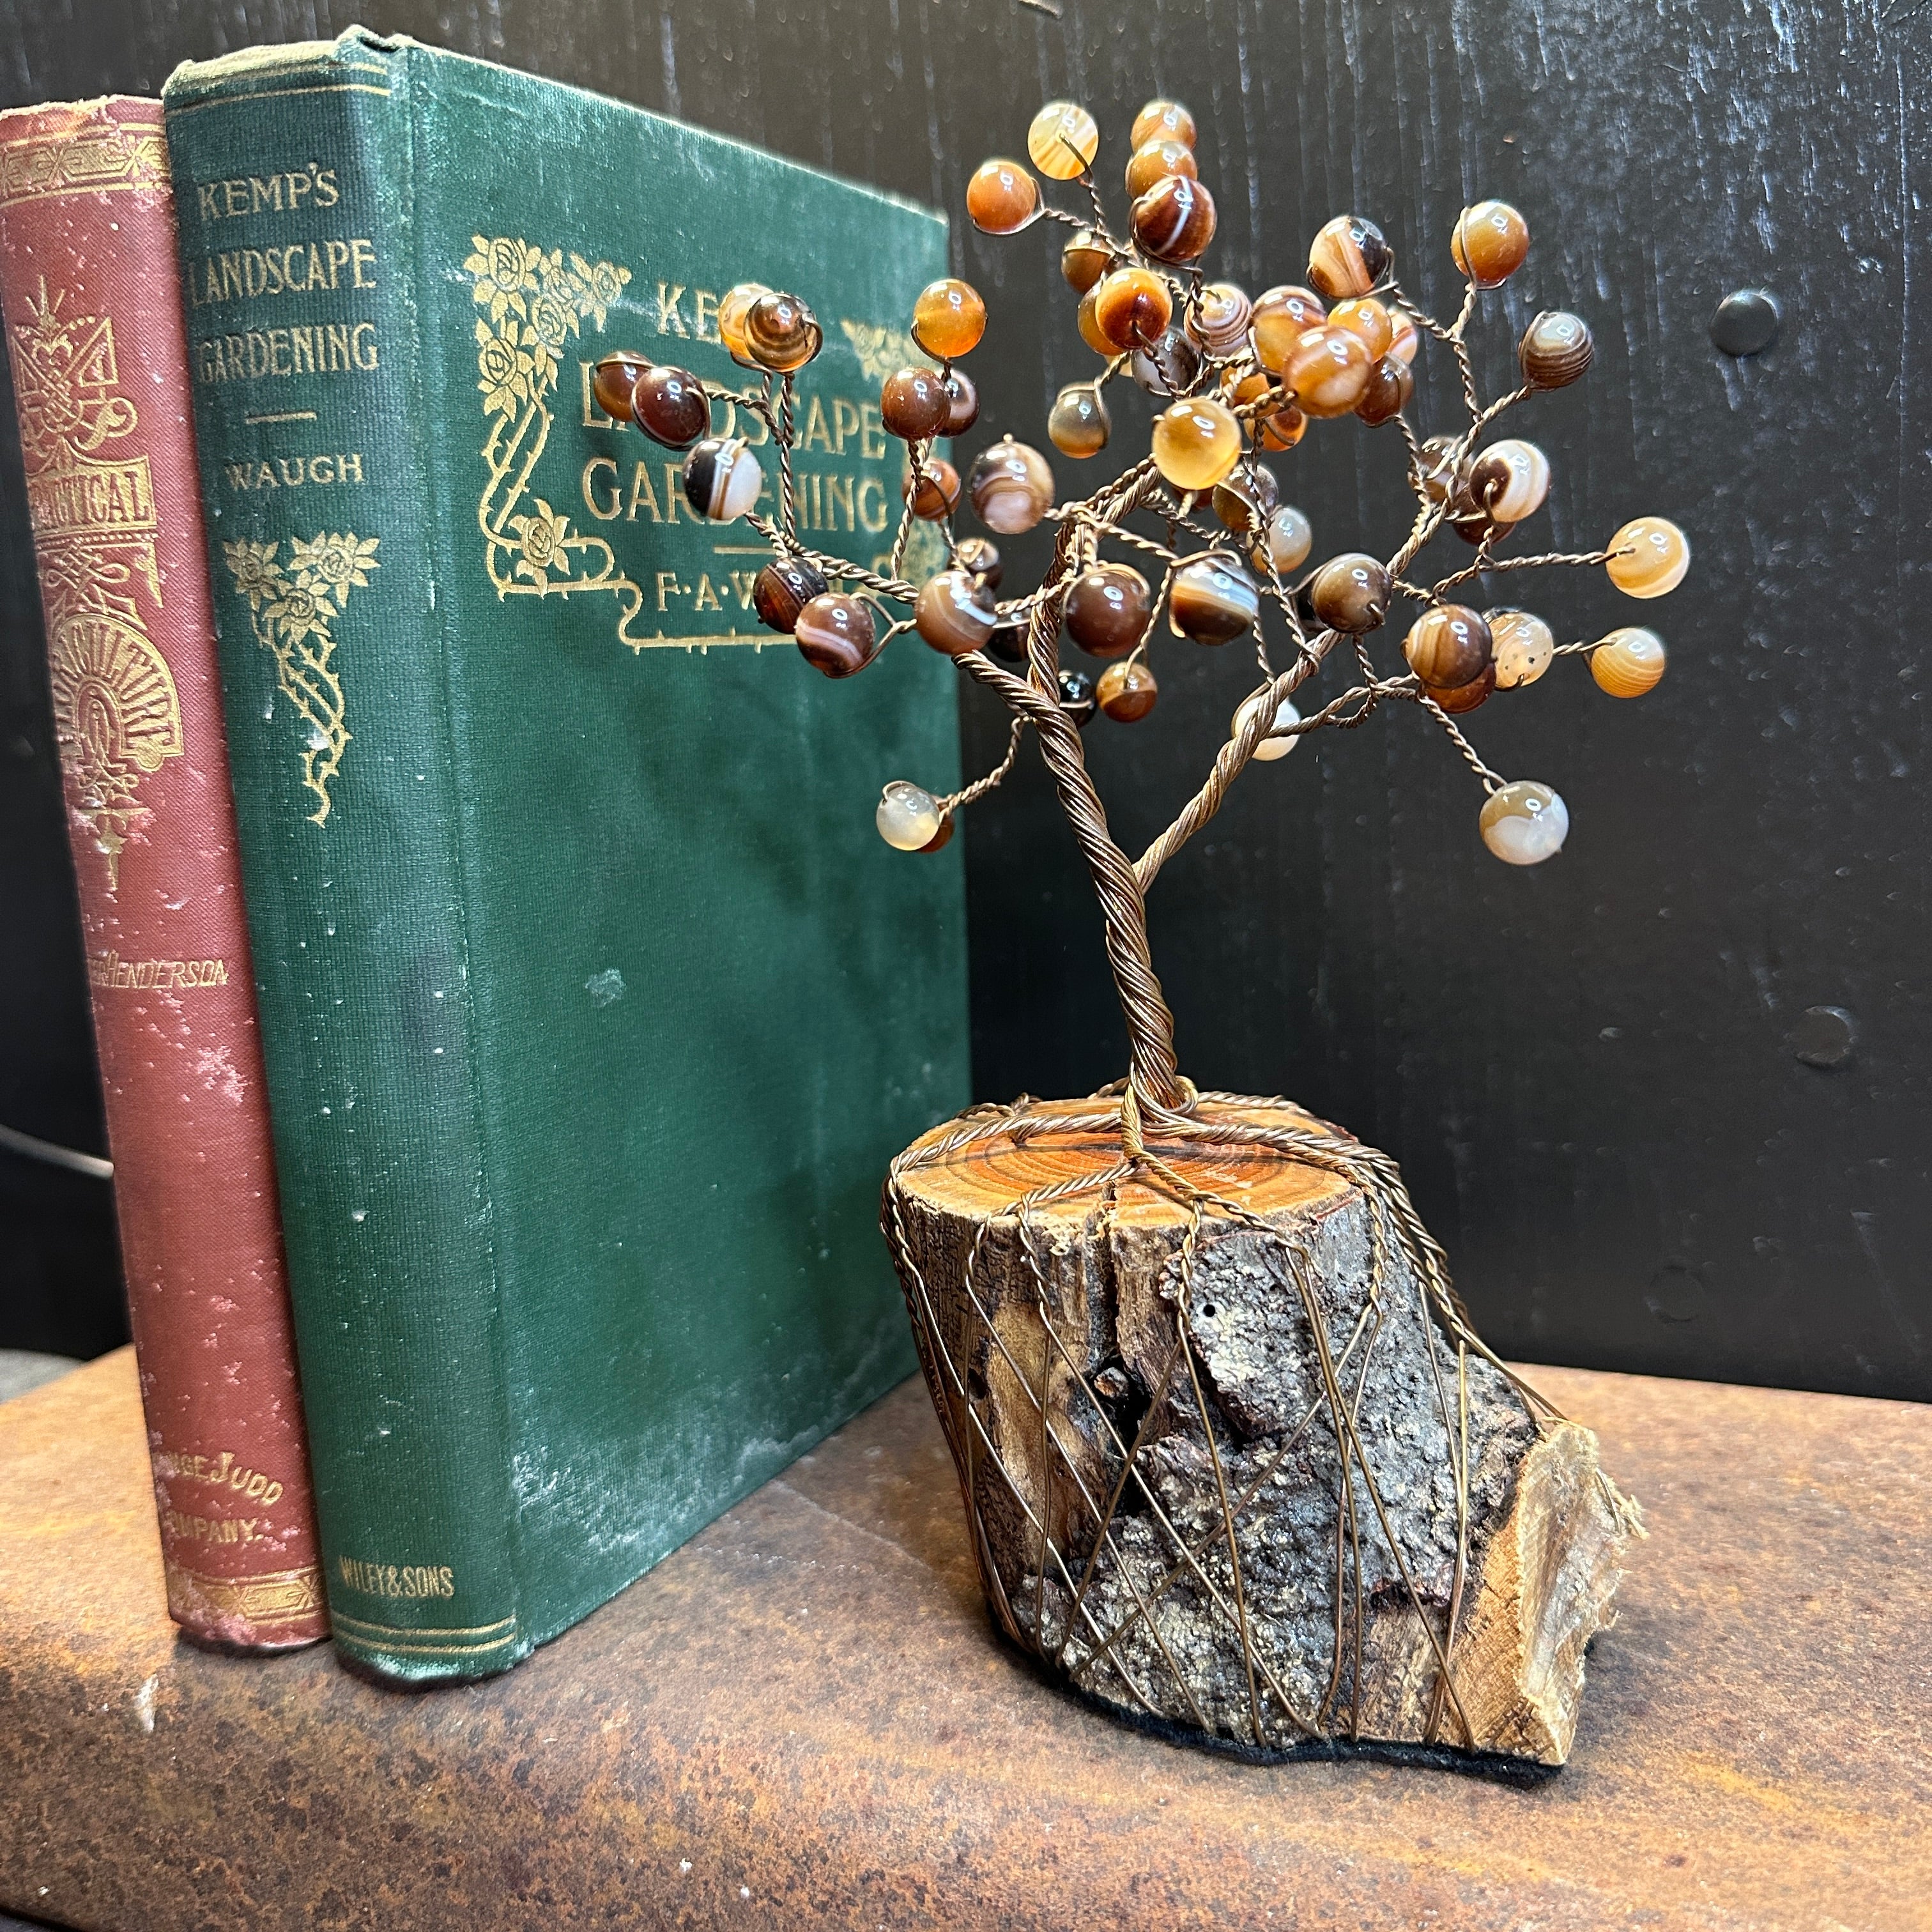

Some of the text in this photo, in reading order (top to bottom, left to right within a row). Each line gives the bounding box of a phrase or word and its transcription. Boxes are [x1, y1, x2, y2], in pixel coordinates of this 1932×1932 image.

[199, 162, 339, 222] KEMP'S
[191, 239, 376, 307] LANDSCAPE
[199, 322, 379, 382] GARDENING
[579, 361, 885, 459] LDSCAPE
[224, 453, 364, 491] WAUGH
[582, 457, 889, 532] GARNING
[210, 1451, 284, 1504] JUDD
